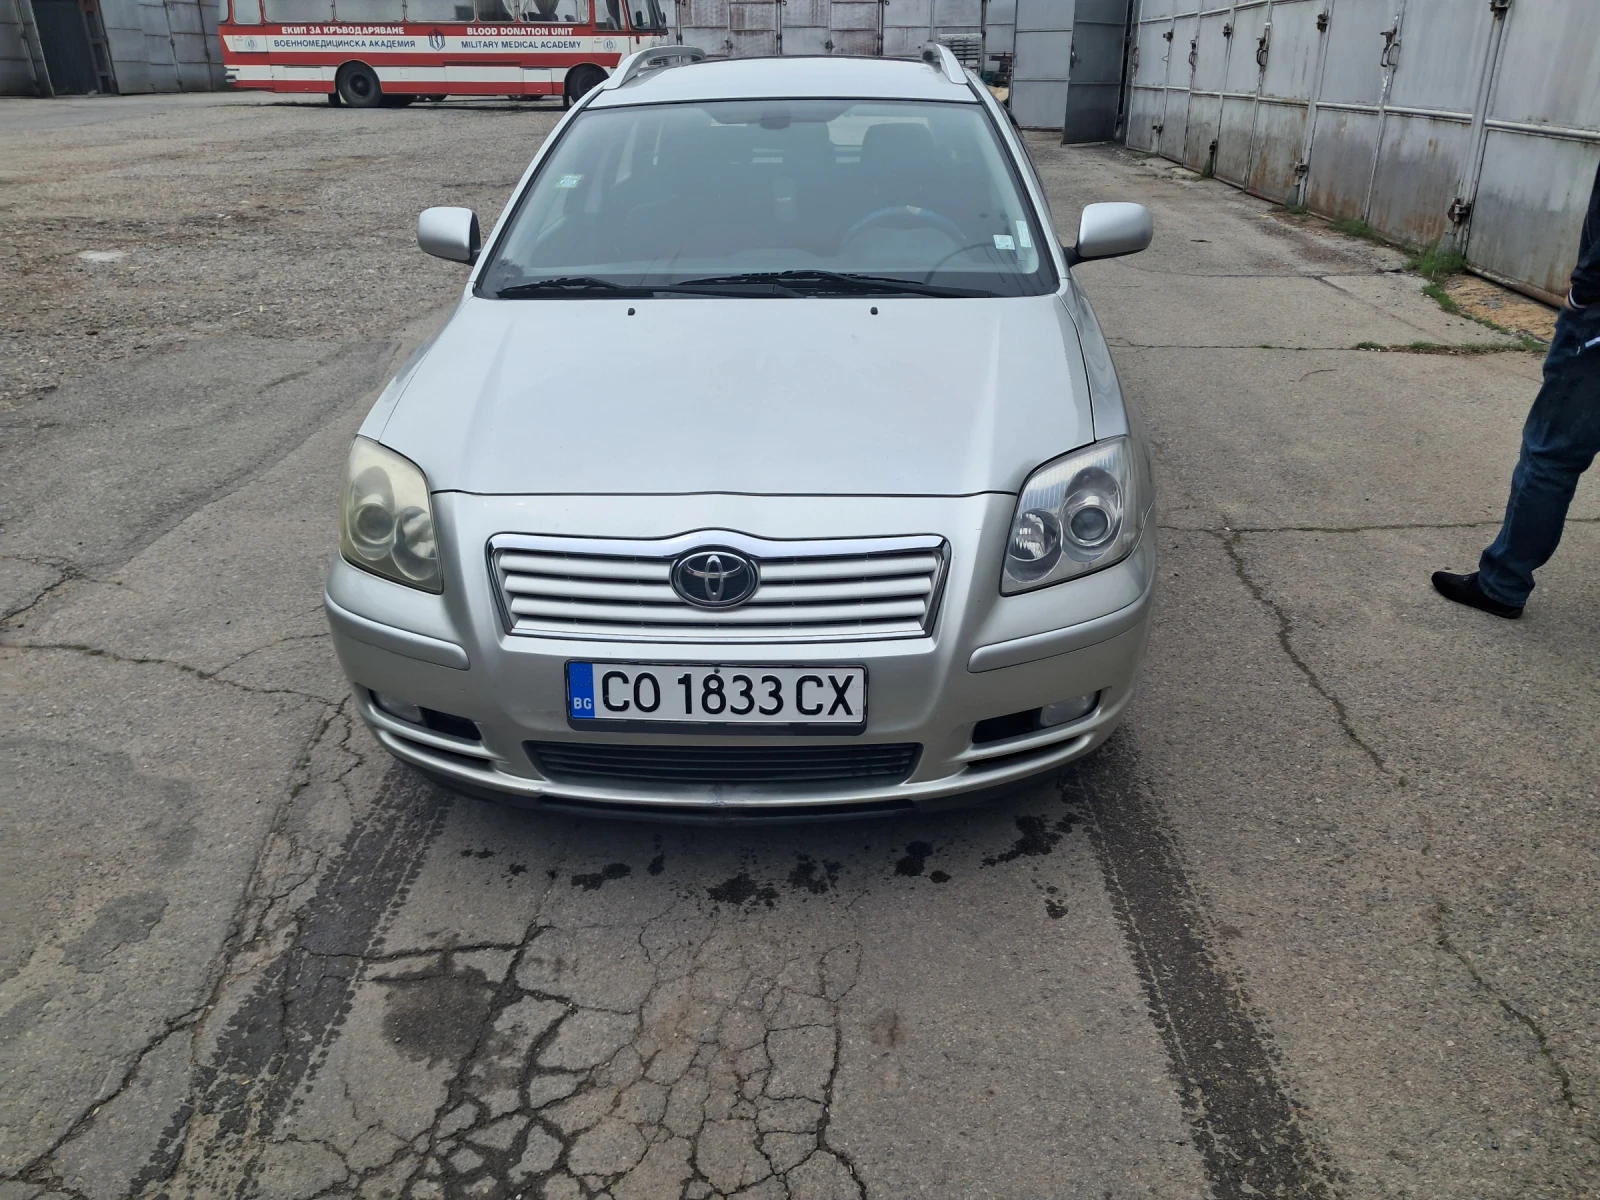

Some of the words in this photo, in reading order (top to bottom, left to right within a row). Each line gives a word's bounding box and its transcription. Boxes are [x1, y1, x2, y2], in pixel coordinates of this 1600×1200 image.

[281, 26, 307, 34] ЕКИП
[309, 26, 321, 34] ЗА
[323, 26, 405, 35] КРЪВОДАРЯВАНЕ
[466, 27, 498, 35] BLOOD
[500, 27, 549, 35] DONATION
[551, 27, 574, 35] UNIT
[273, 39, 367, 48] ВОЕННОМЕДИЦИНСКА
[369, 40, 416, 49] АКАДЕМИЯ
[602, 670, 661, 713] CO
[677, 673, 784, 716] 1833
[796, 674, 855, 716] CX
[573, 697, 592, 709] BG
